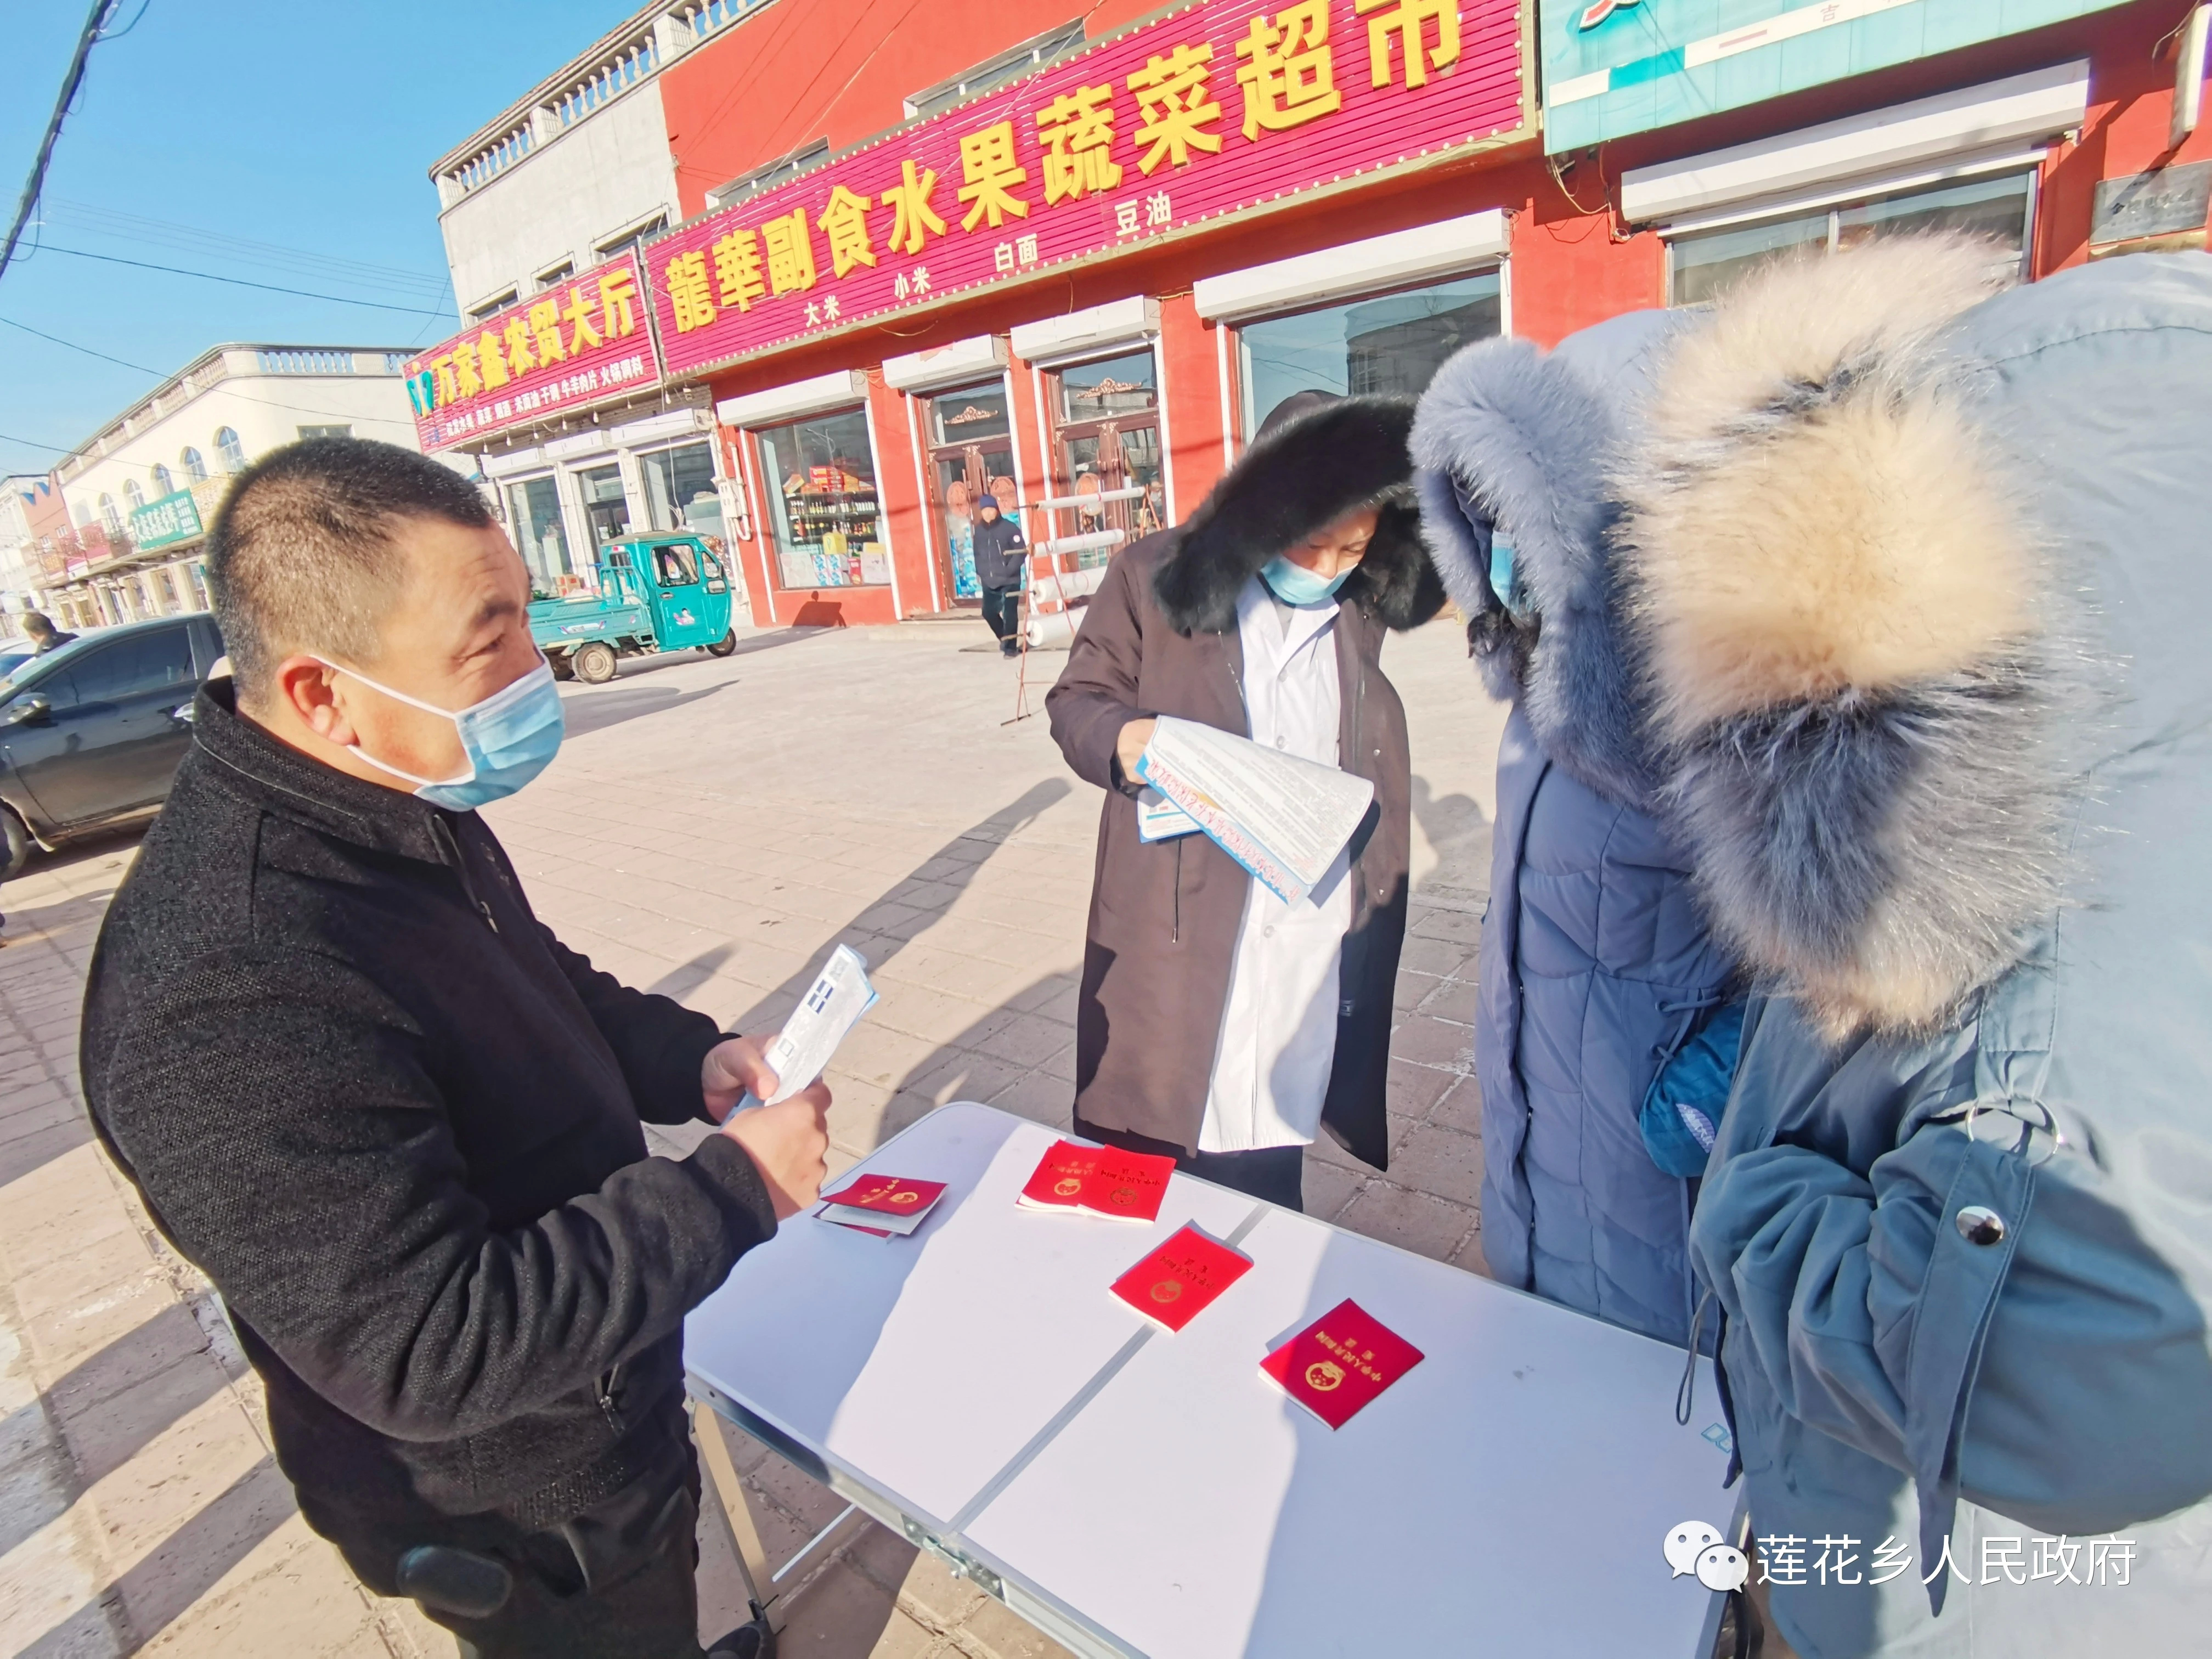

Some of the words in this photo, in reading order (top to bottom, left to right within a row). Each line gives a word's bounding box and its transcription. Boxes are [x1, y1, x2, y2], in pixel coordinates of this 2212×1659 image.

[665, 0, 1463, 334] 龍華副食水果蔬菜超市
[1114, 190, 1172, 238] 豆油
[994, 233, 1038, 273] 白面
[894, 266, 932, 300] 小米
[804, 295, 841, 328] 大米
[431, 268, 635, 408] 万家鑫农贸大厅
